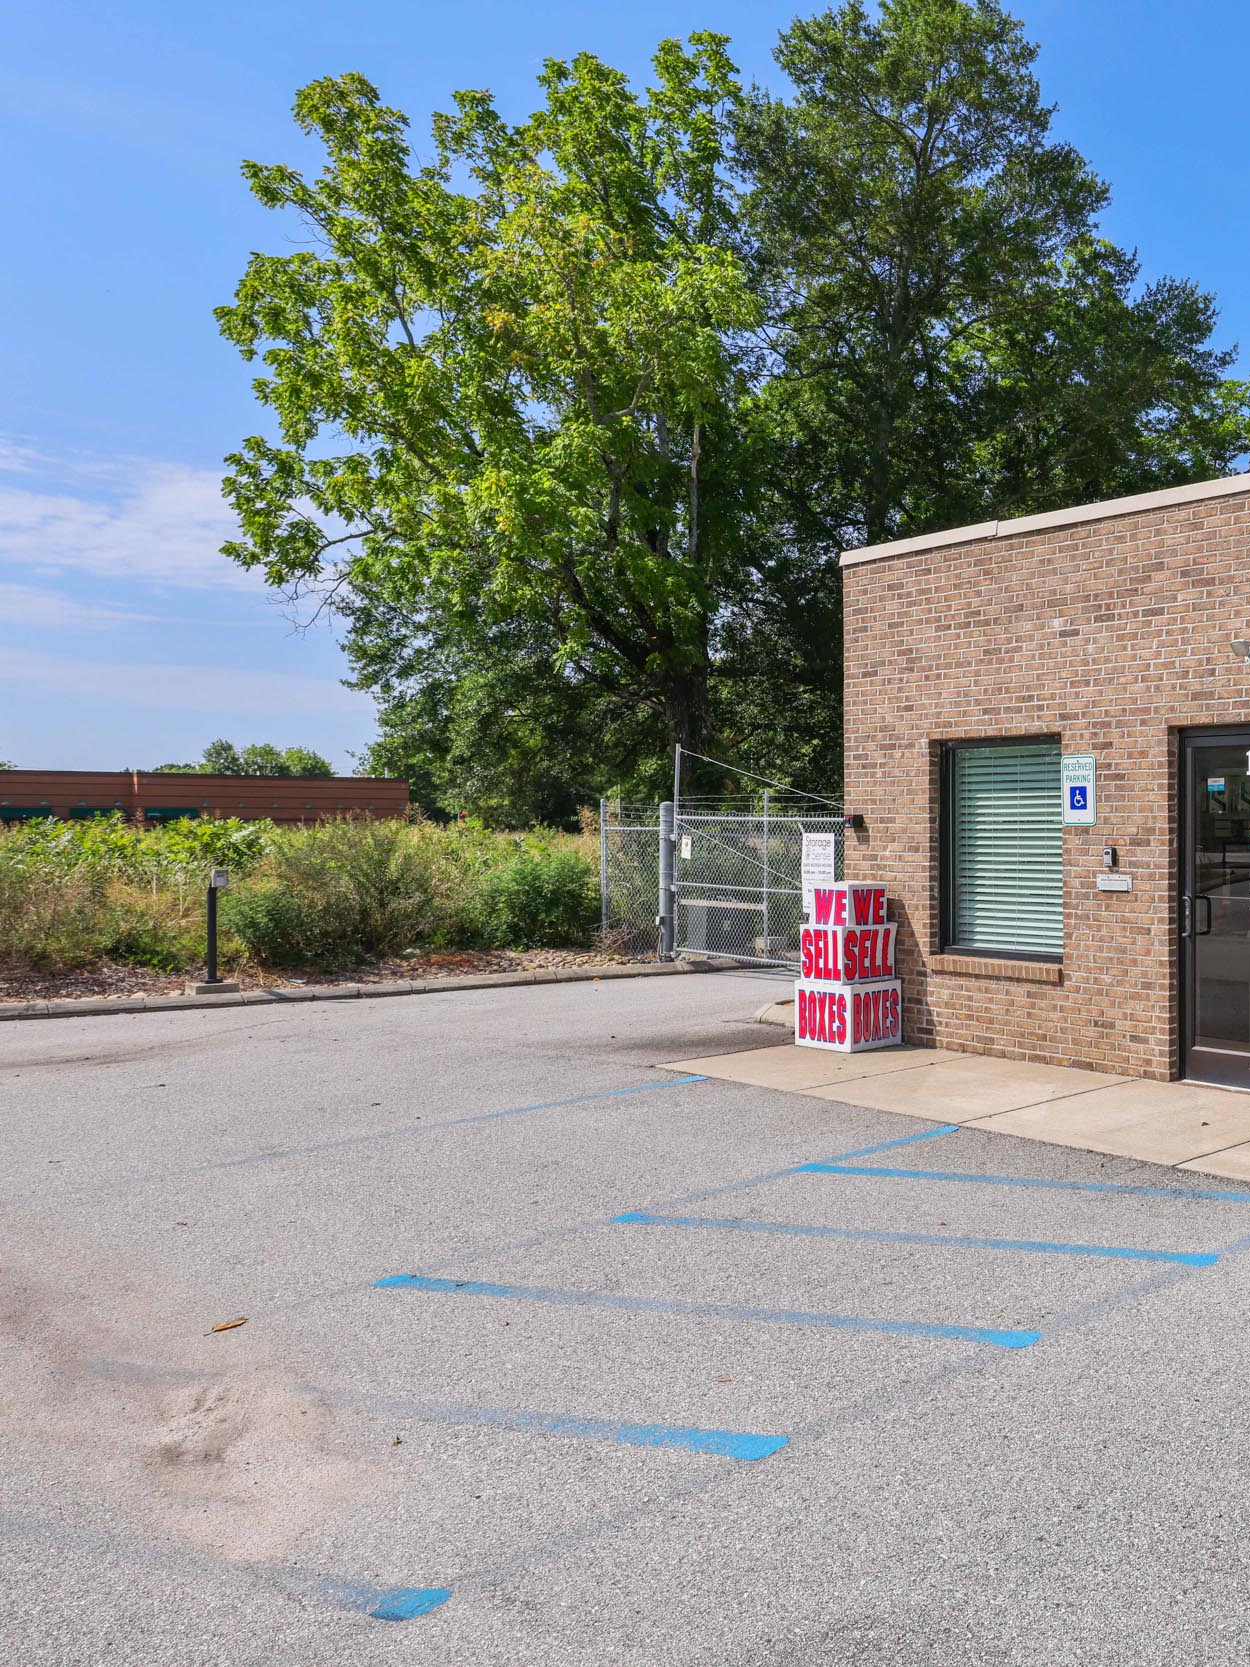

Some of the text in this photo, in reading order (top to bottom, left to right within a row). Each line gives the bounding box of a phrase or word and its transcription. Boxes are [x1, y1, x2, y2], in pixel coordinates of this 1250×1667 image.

[1064, 762, 1093, 772] RESERVED
[1065, 774, 1091, 783] PARKING
[805, 835, 831, 850] Storage
[811, 849, 831, 860] Sense
[814, 889, 847, 926] WE
[853, 889, 885, 926] WE
[801, 928, 842, 981] SELL
[844, 928, 893, 981] SELL
[798, 989, 847, 1045] BOXES
[853, 988, 899, 1044] BOXES
